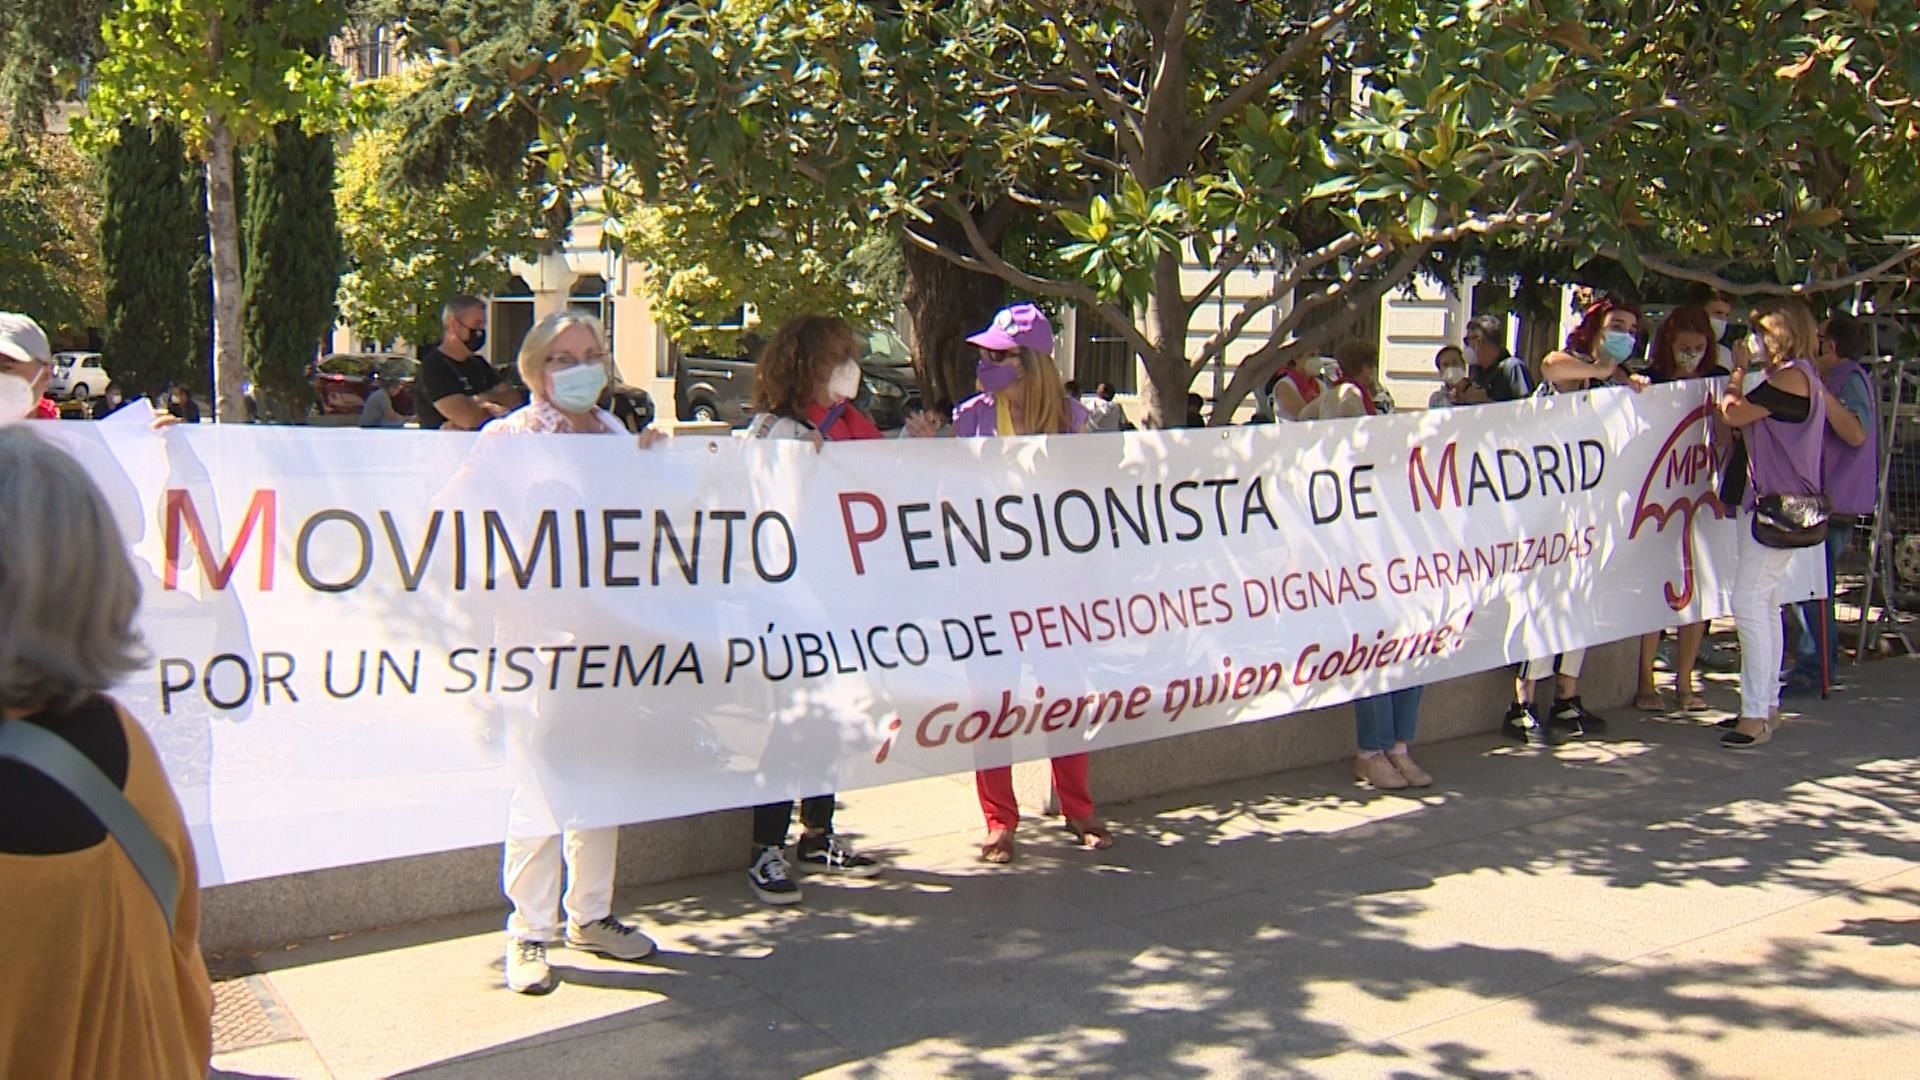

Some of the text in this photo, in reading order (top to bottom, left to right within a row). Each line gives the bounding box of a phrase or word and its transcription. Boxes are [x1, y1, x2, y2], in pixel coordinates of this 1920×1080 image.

[163, 439, 1606, 592] MOVIMIENTO PENSIONISTA DE MADRID
[160, 525, 1596, 714] POR UN SISTEMA PÚBLICO DE PENSIONES DIGNAS GARANTIZADAS
[916, 685, 1152, 748] Gobierne
[1164, 657, 1283, 721] quien
